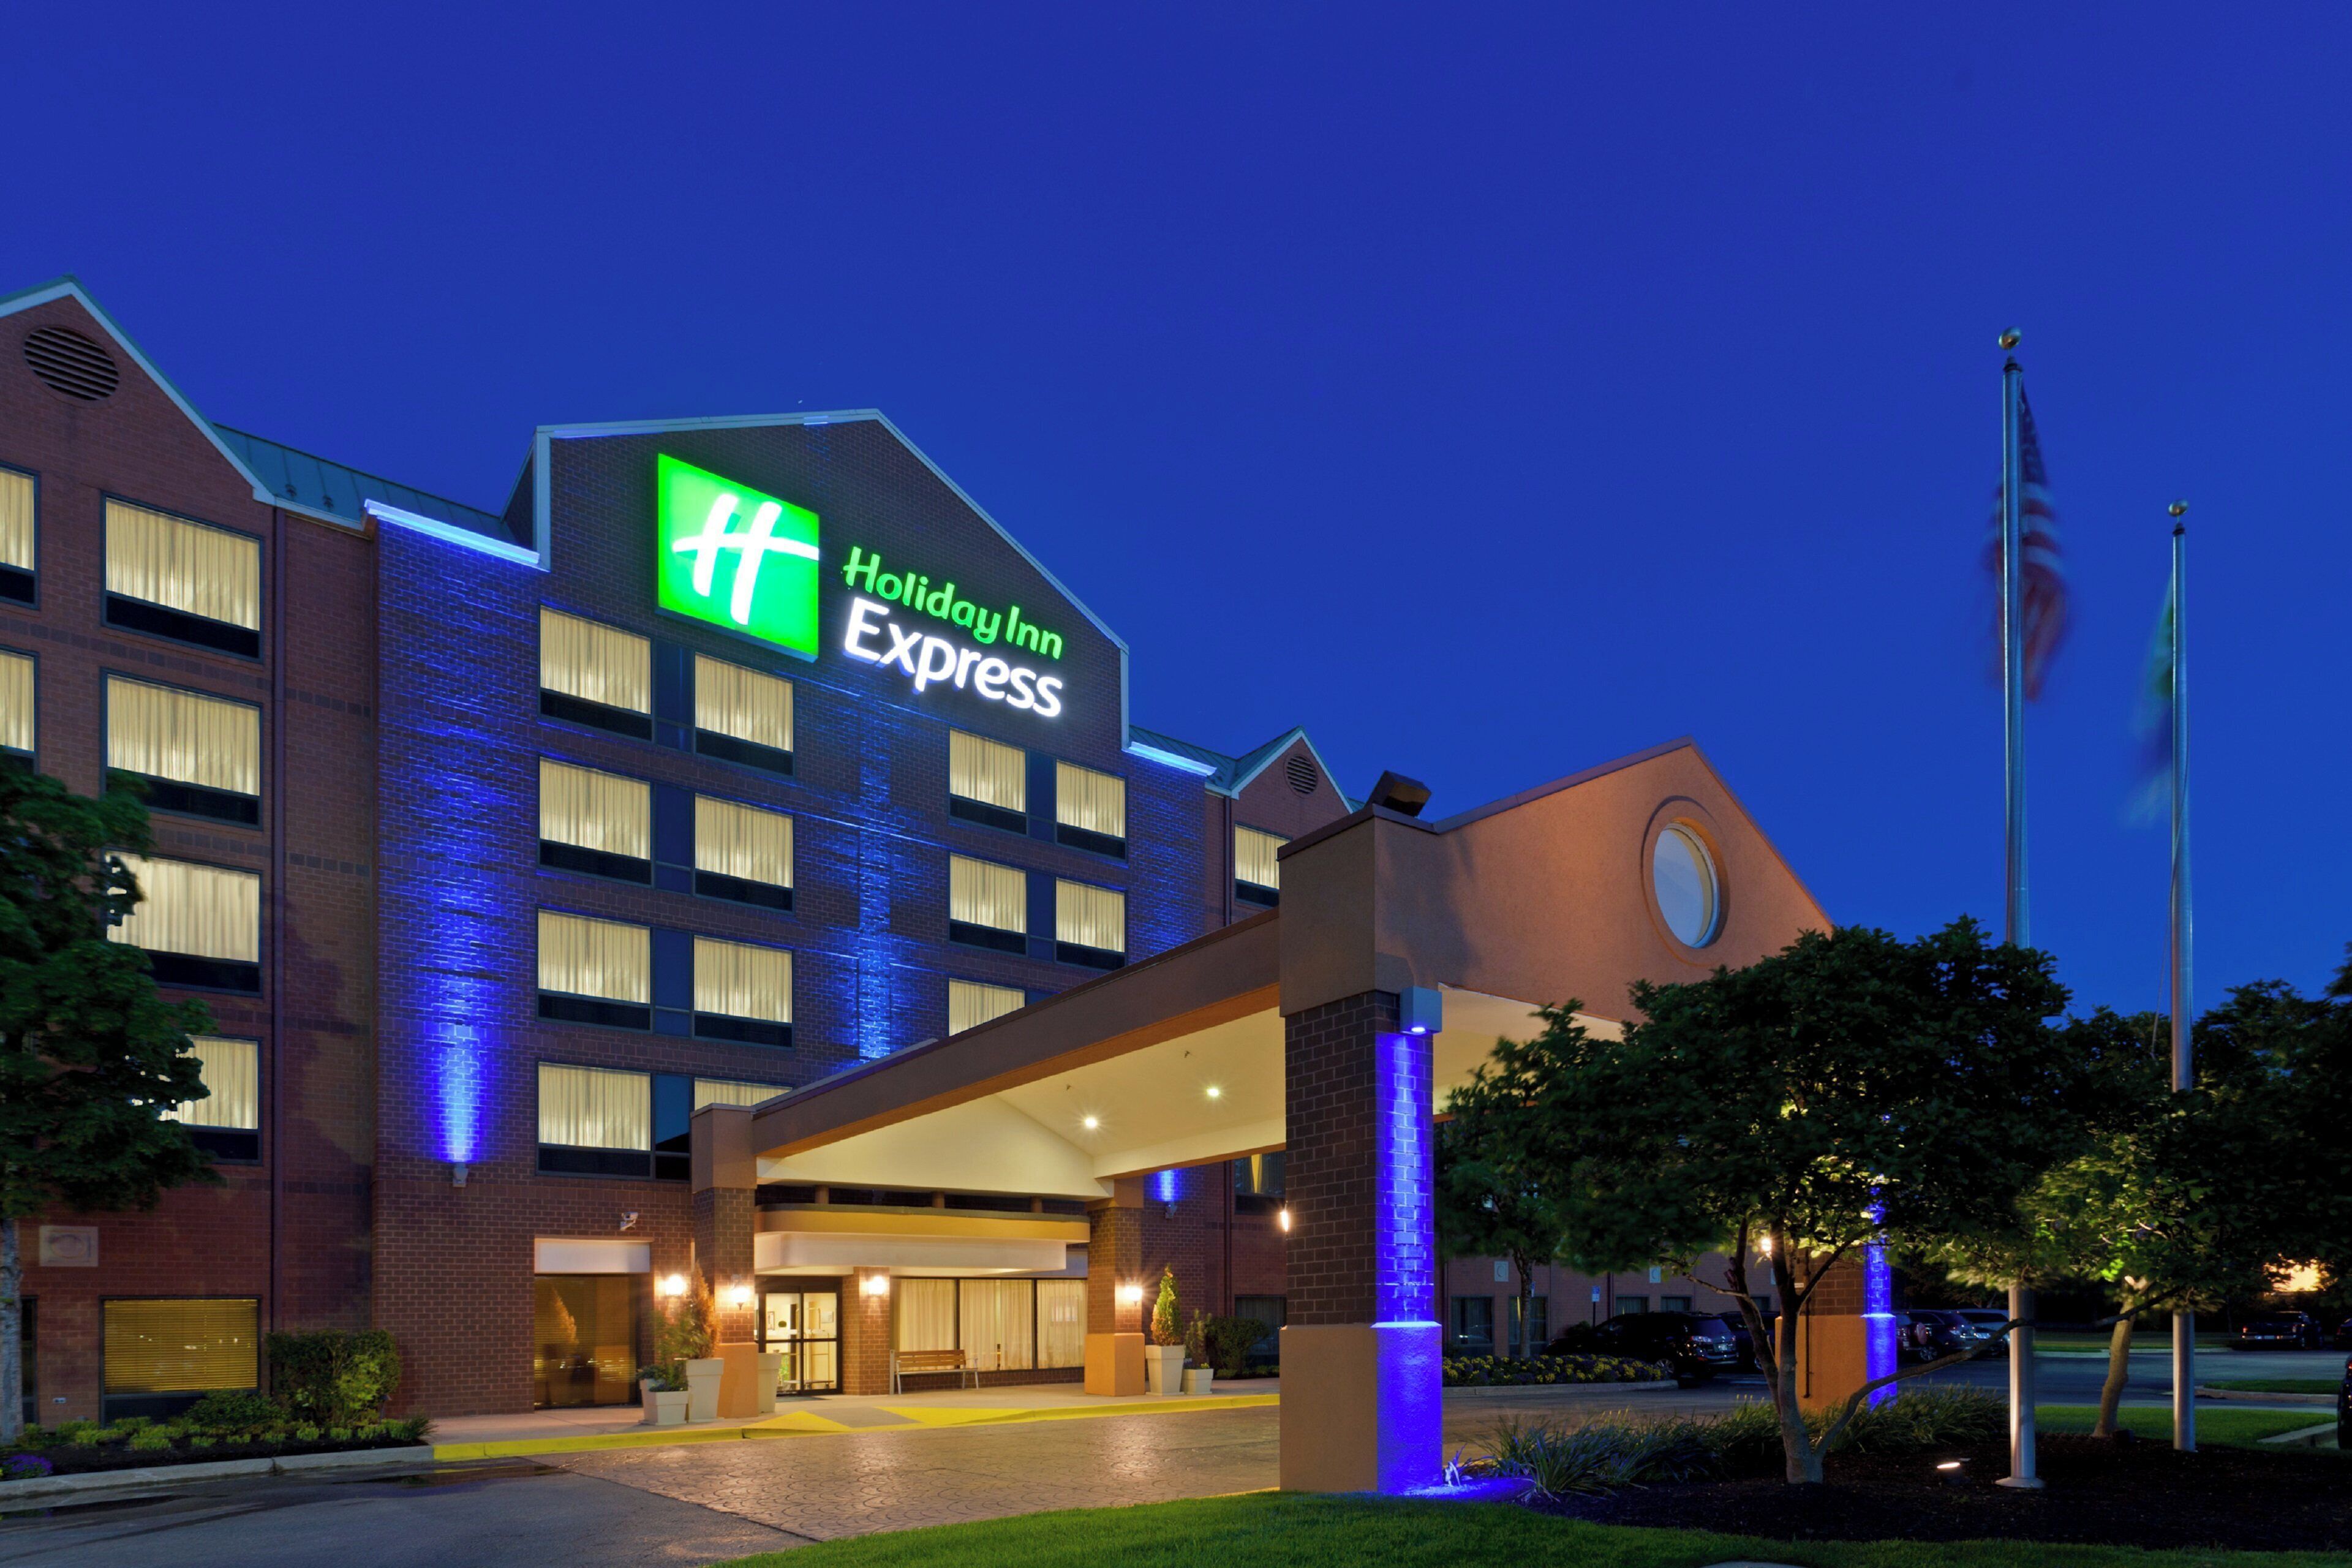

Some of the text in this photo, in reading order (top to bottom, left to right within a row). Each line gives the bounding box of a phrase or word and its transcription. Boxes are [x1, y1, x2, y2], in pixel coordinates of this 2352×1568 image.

[673, 494, 819, 625] H
[843, 546, 1063, 659] Holiday Inn
[843, 597, 1063, 717] Express
